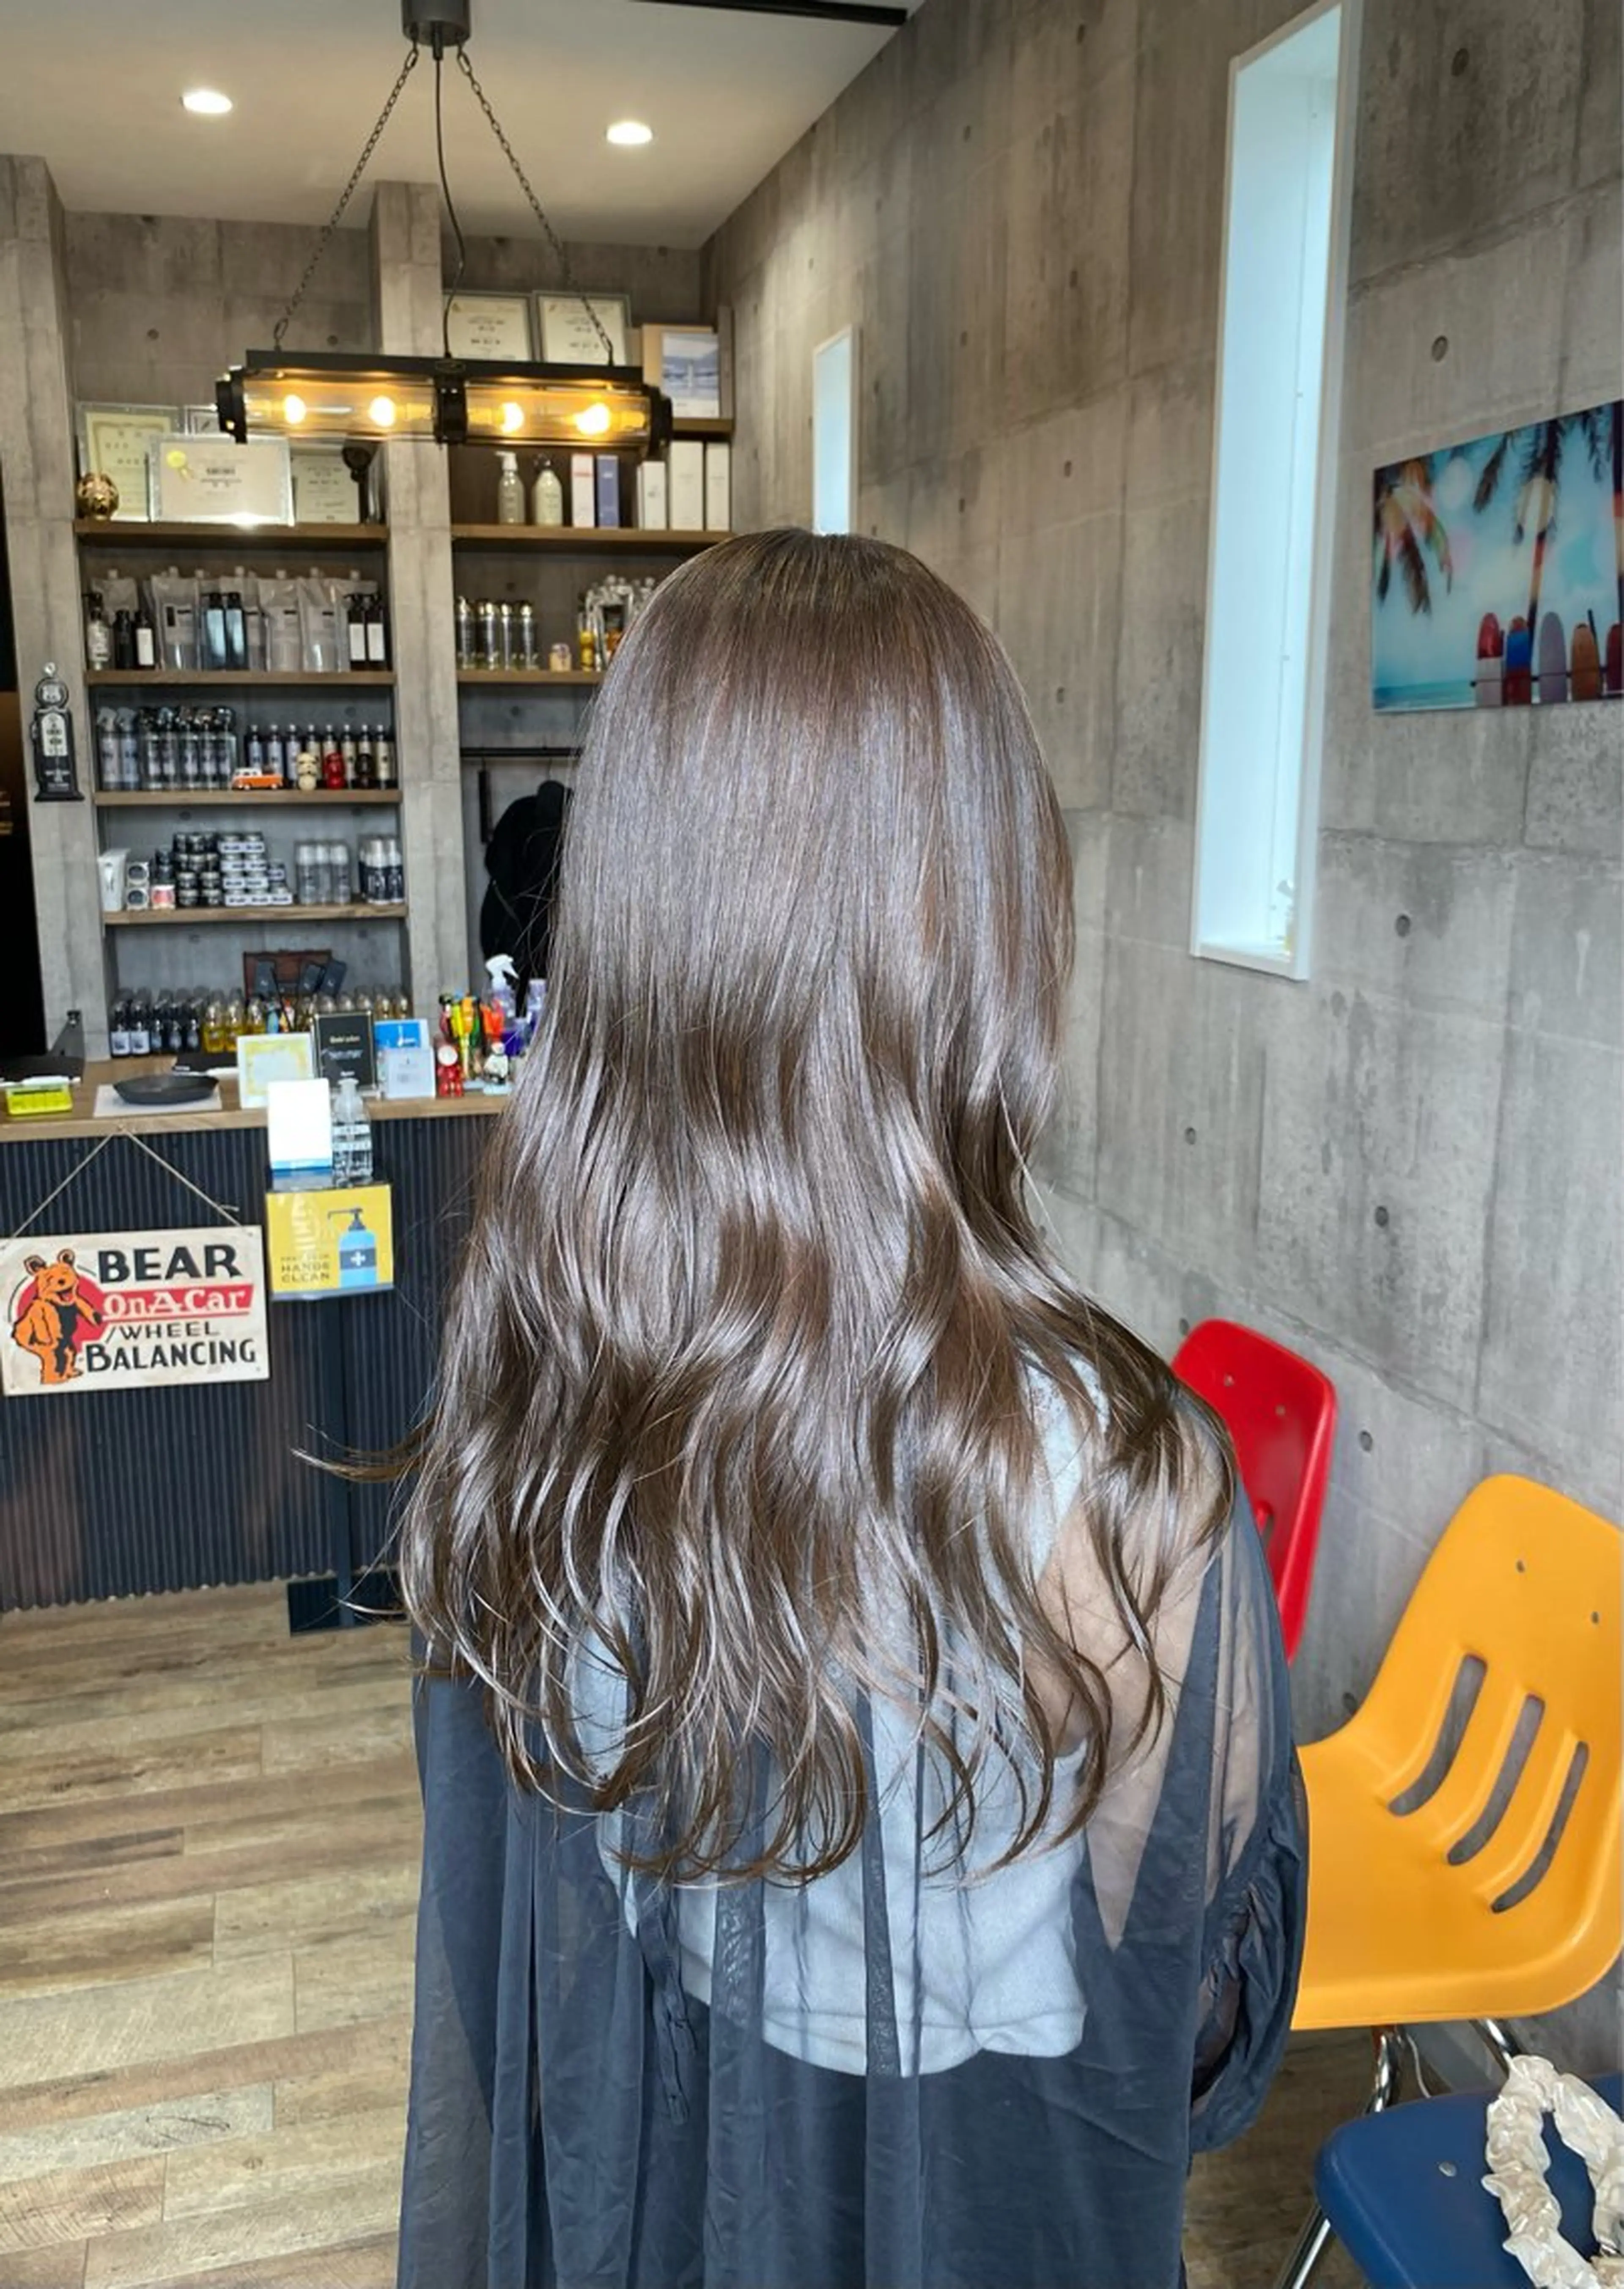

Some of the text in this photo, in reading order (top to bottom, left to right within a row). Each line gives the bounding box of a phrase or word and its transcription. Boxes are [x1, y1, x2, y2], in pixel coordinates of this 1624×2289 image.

[98, 1244, 243, 1283] BEAR
[184, 1288, 246, 1313] Car
[119, 1321, 220, 1340] WHEEL
[85, 1338, 255, 1372] BALANCING
